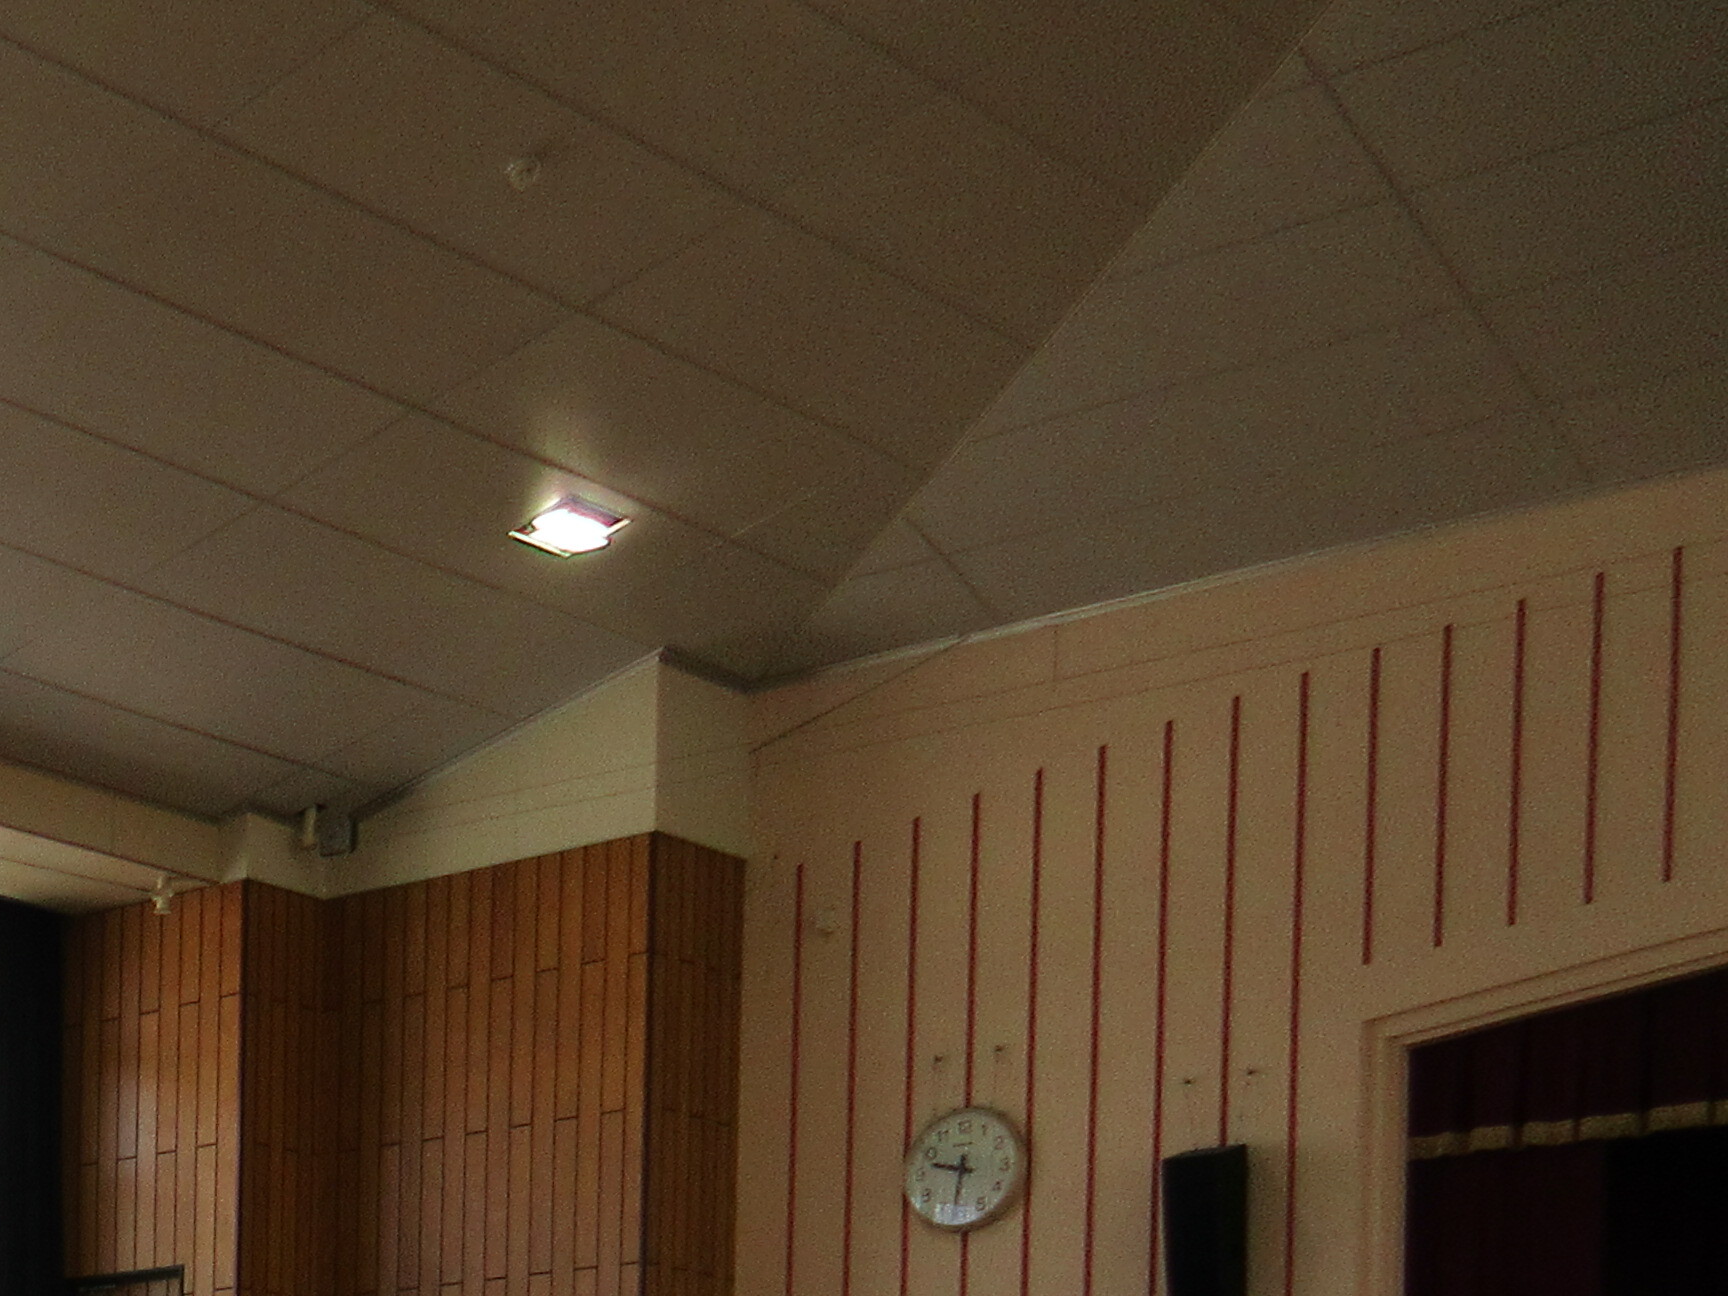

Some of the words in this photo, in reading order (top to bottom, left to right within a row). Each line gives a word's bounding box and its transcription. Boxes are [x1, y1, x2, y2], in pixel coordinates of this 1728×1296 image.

[994, 1136, 1004, 1150] 2
[999, 1157, 1011, 1172] 3
[991, 1181, 1003, 1192] 4
[975, 1197, 987, 1212] 5
